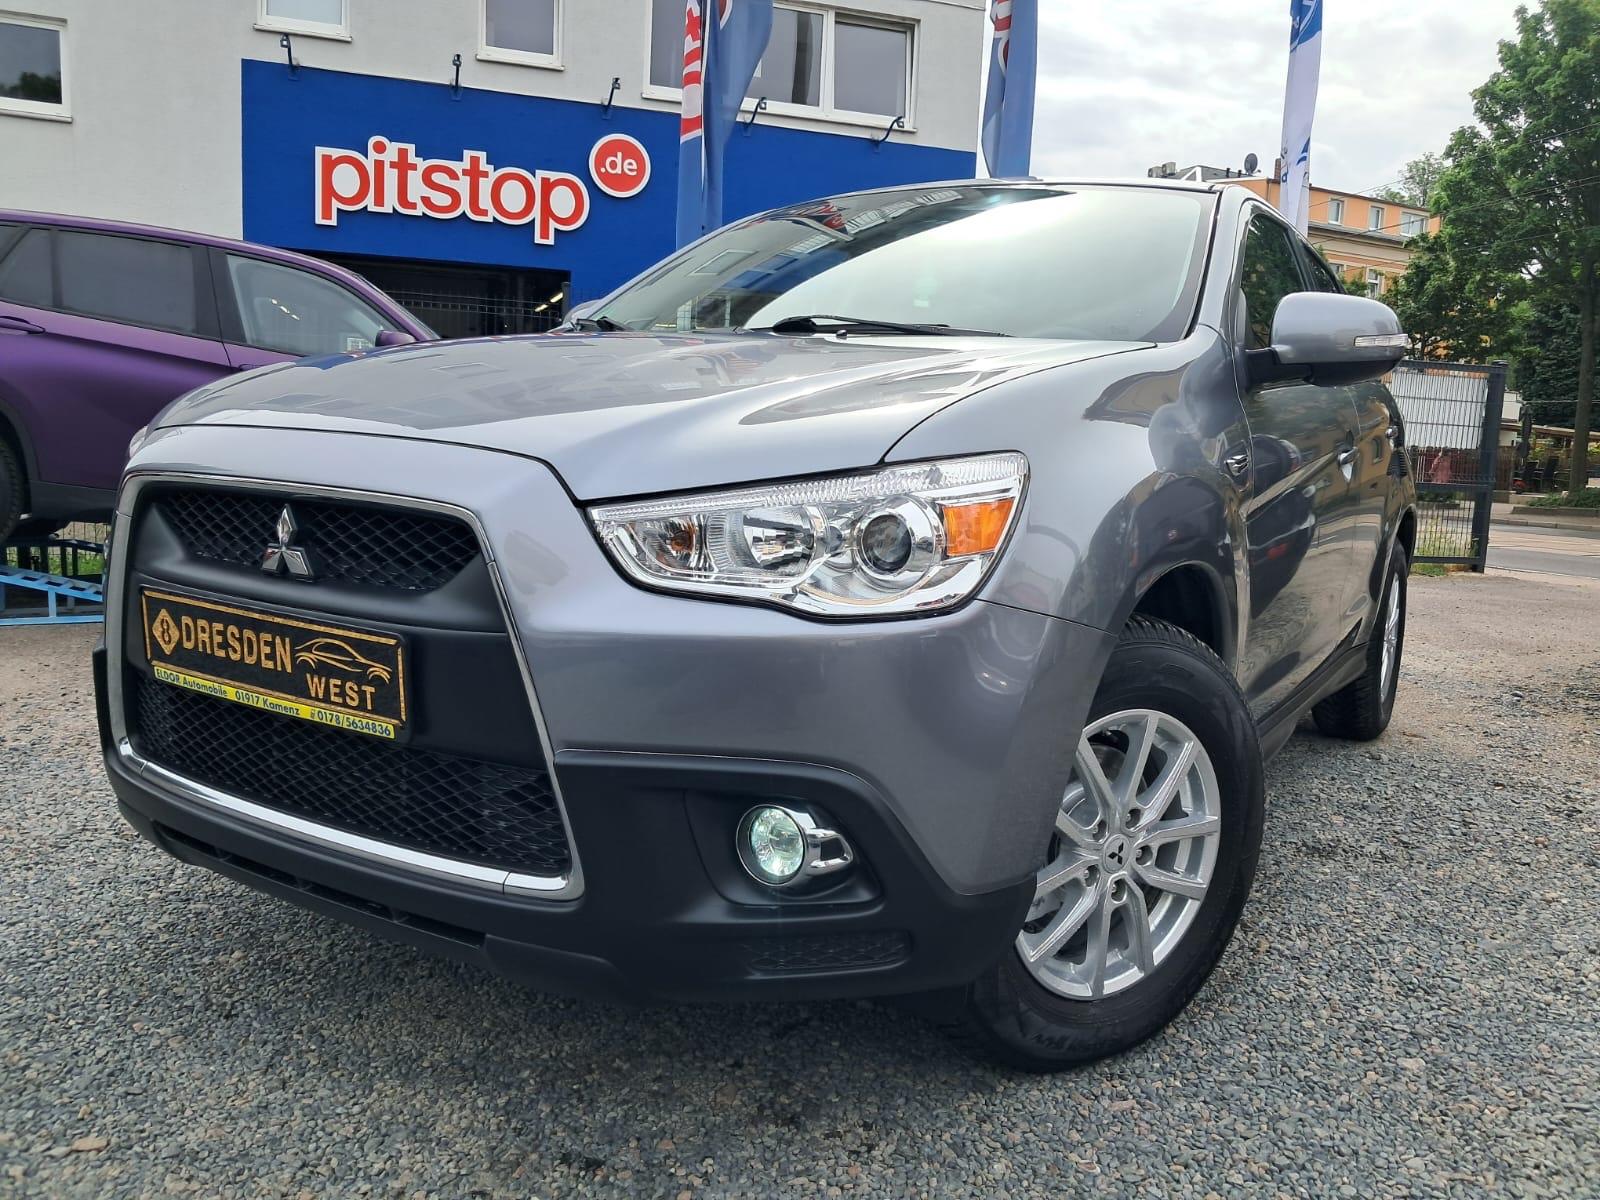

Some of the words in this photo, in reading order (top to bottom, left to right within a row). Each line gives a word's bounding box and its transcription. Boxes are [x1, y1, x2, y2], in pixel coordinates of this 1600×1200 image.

[317, 137, 588, 242] pitstop
[181, 615, 293, 673] DRESDEN
[182, 676, 228, 697] Automobile
[234, 690, 261, 706] 01917
[262, 697, 300, 716] Kamenz
[317, 710, 391, 737] 0178/5634836
[306, 673, 376, 710] WEST
